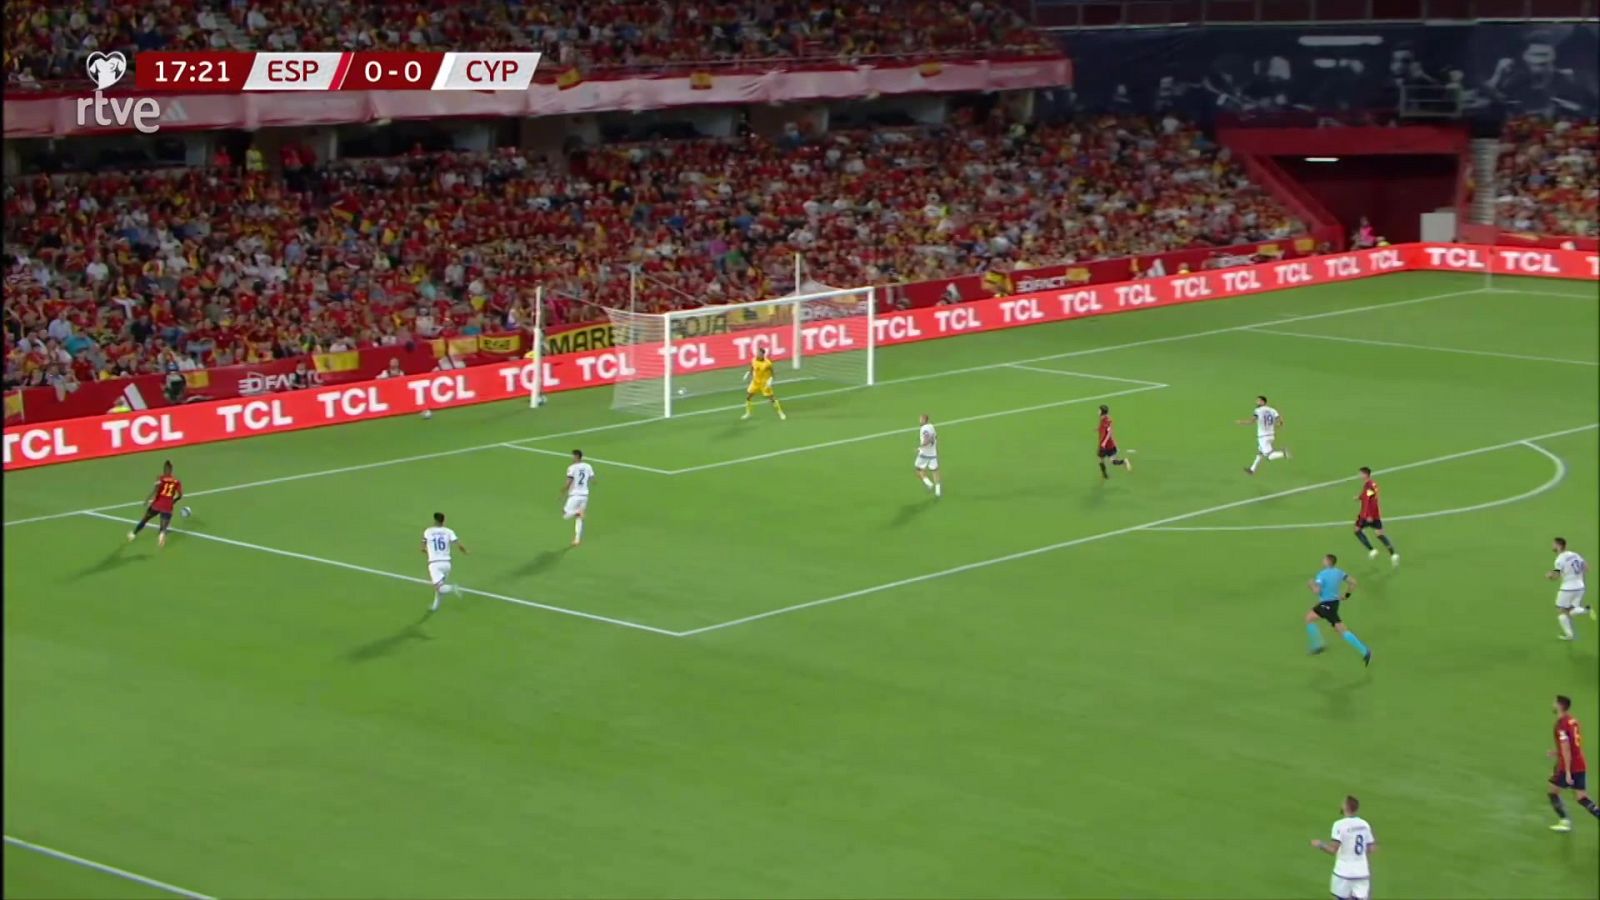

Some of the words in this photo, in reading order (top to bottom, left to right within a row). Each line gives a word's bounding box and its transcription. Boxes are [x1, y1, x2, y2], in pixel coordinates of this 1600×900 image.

[1424, 247, 1485, 269] TCL
[1500, 250, 1561, 274] TCL
[102, 414, 184, 448] TCL
[217, 400, 294, 432] TCL
[317, 387, 389, 419] TCL
[408, 375, 476, 405] TCL
[500, 363, 561, 392] TCL
[576, 352, 637, 381] TCL
[733, 333, 787, 361] TCL
[802, 323, 854, 350] TCL
[874, 315, 921, 341] TCL
[934, 308, 981, 332] TCL
[1000, 297, 1044, 323] TCL
[1059, 290, 1103, 314] TCL
[1115, 283, 1158, 306] TCL
[1171, 276, 1212, 299] TCL
[1222, 269, 1261, 291] TCL
[1275, 262, 1313, 284] TCL
[1325, 255, 1361, 276] TCL
[1370, 249, 1404, 270] TCL
[577, 471, 587, 486] 2
[159, 482, 175, 497] 11
[431, 536, 447, 552] 16
[1354, 833, 1365, 857] 8
